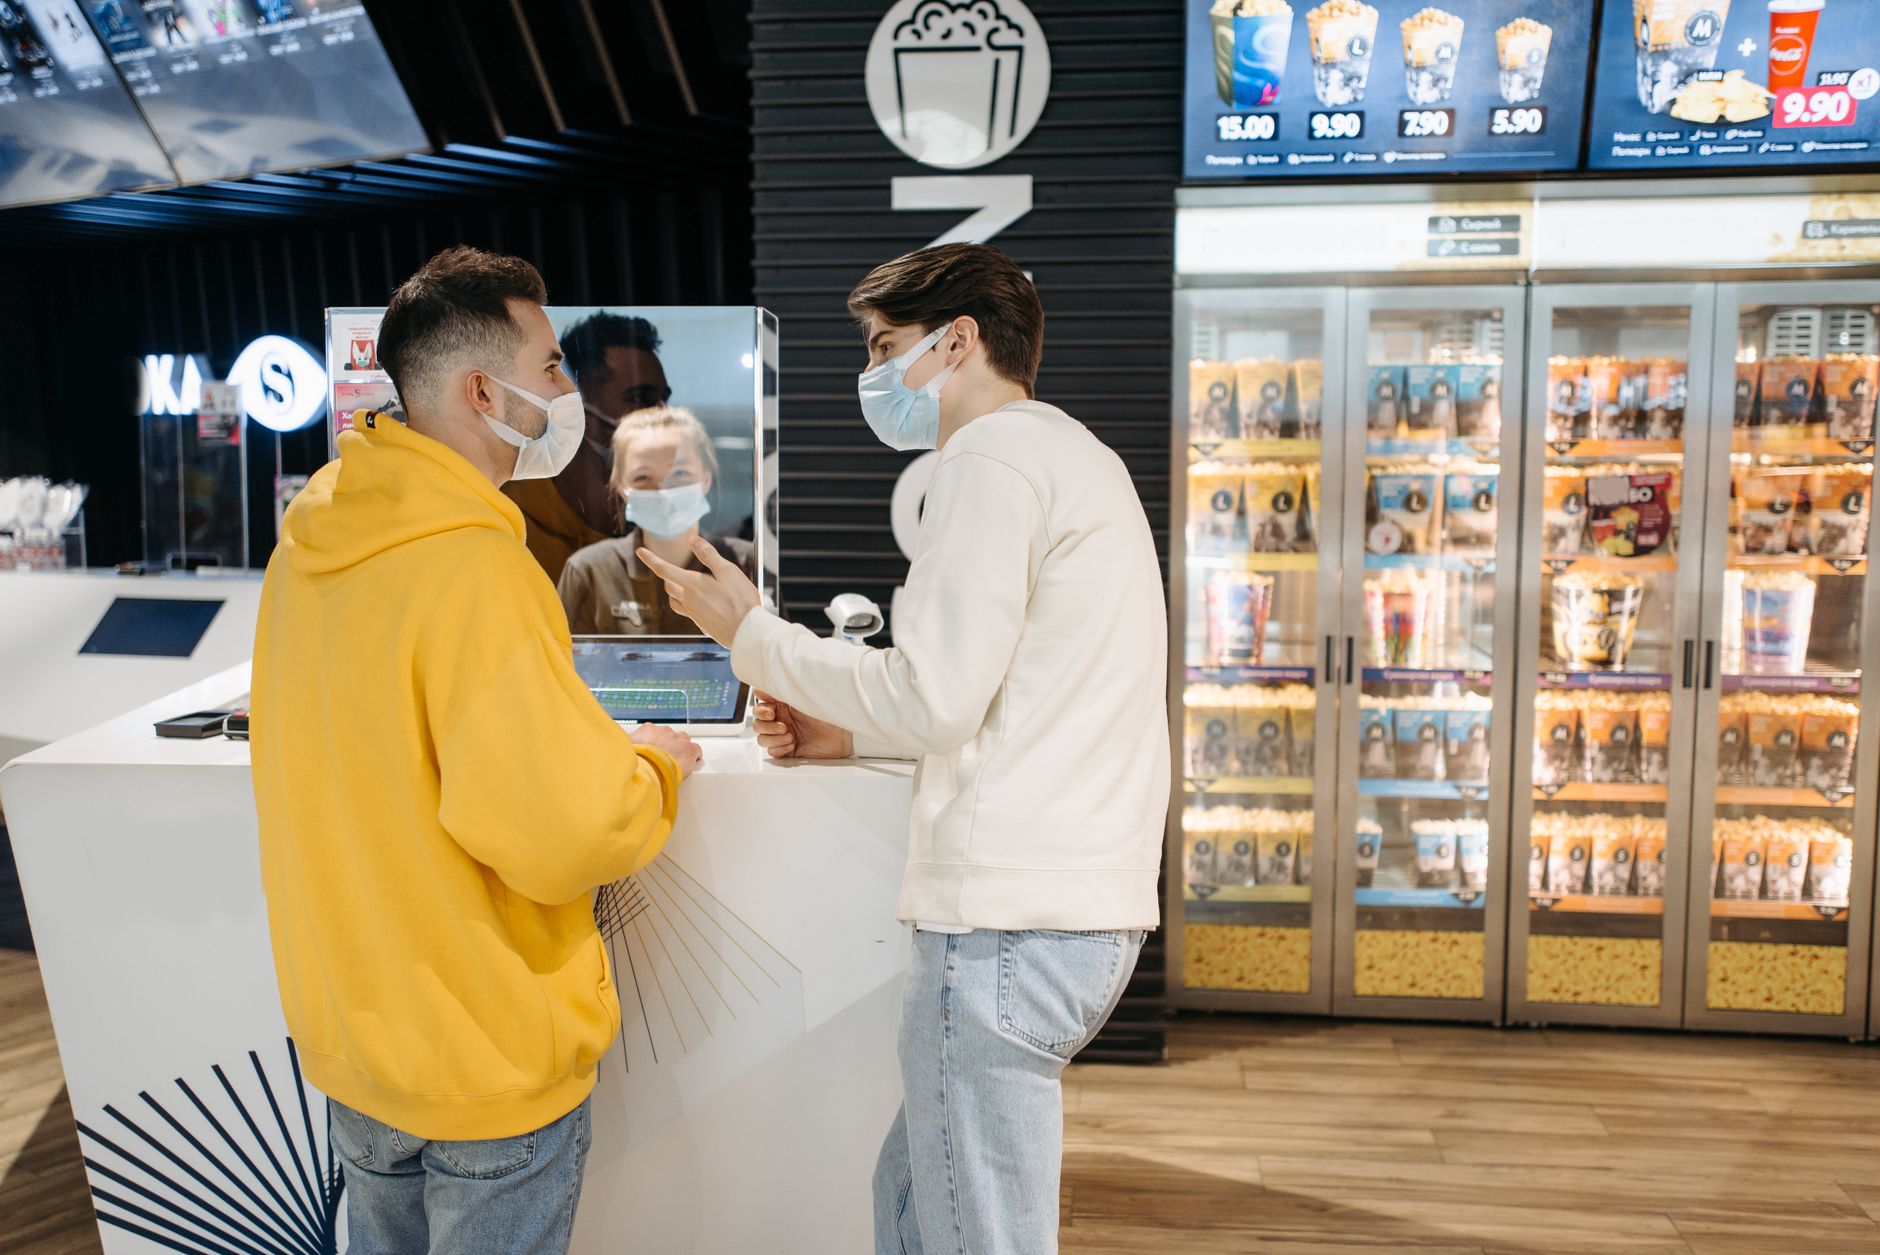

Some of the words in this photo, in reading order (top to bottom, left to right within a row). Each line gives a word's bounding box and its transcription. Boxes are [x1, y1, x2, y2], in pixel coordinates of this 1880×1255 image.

[1691, 18, 1712, 38] M
[1351, 39, 1364, 56] L
[1439, 47, 1452, 59] M
[1782, 91, 1851, 124] 9.90
[1217, 115, 1275, 140] 15.00
[1311, 112, 1361, 138] 9.90
[1403, 110, 1449, 136] 7.90
[1491, 108, 1543, 134] 5.90
[263, 354, 294, 414] S
